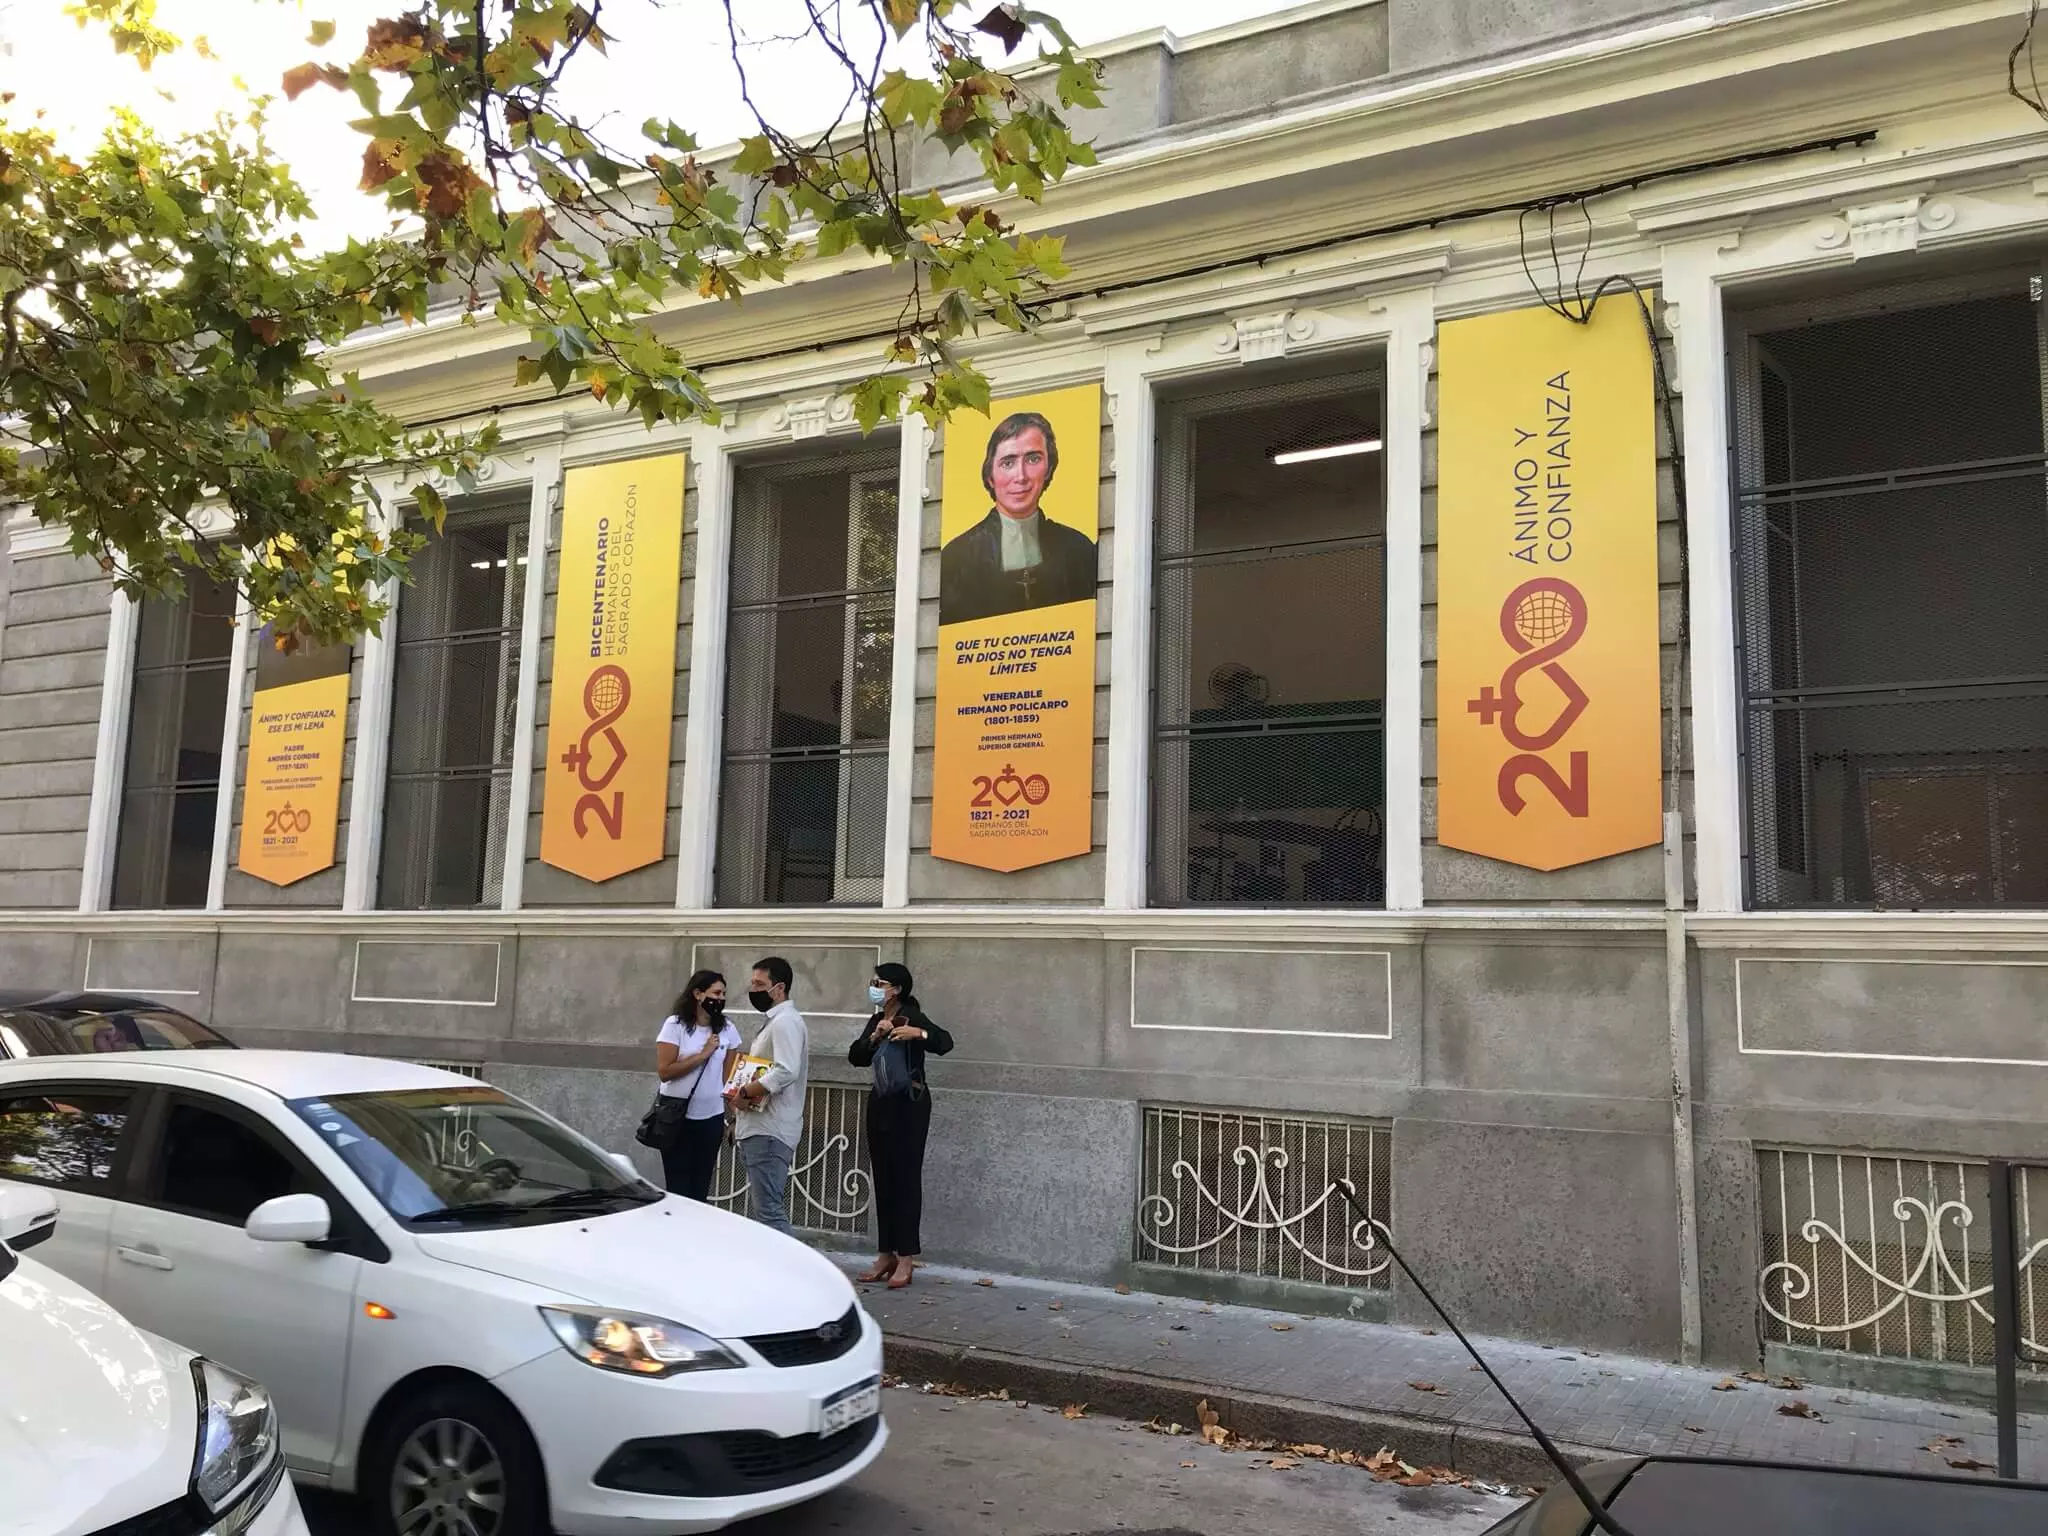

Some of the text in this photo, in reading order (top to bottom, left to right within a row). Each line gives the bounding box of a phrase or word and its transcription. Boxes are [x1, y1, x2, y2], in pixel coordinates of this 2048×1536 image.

[1546, 370, 1572, 562] CONFIANZA
[1509, 427, 1538, 564] ÁNIMO Y
[617, 484, 637, 656] SAGRADO CORAZÓN
[590, 517, 610, 658] BICENTENARIO
[604, 525, 623, 656] HERMANOS DEL
[955, 630, 1075, 651] QUE TU CONFIANZA
[956, 645, 1072, 665] EN DIOS NO TENGA
[989, 662, 1037, 676] LÍMITES
[982, 689, 1043, 702] VENERABLE
[957, 700, 1069, 716] HERMANO POLICARPO
[284, 712, 290, 721] Y
[984, 714, 1040, 726] (1801-1859)
[268, 724, 282, 734] ESE
[283, 723, 293, 732] ES
[303, 721, 325, 730] LEMA
[1007, 732, 1042, 741] HERMANO
[978, 741, 1046, 751] SUPERIOR GENERAL
[970, 810, 992, 821] 1821
[1002, 809, 1030, 820] 2021
[970, 820, 1030, 830] HERMANOS DEL
[969, 829, 1008, 838] SAGRADO
